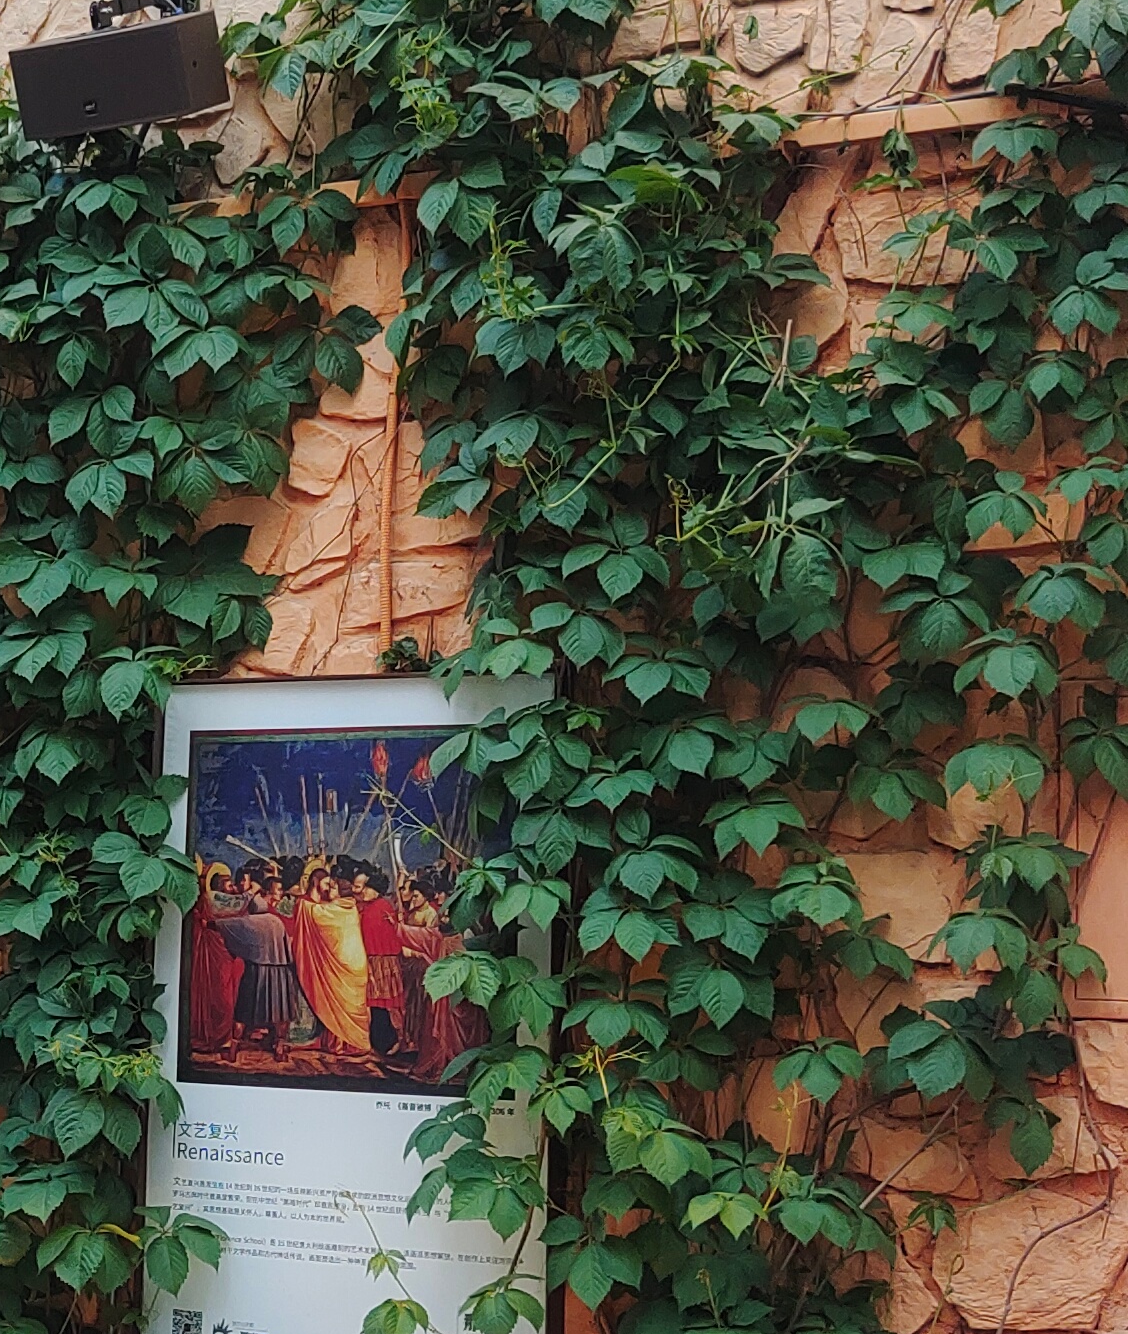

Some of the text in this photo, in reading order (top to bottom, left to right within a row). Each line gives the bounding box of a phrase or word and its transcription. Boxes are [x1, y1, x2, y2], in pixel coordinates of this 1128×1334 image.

[178, 1121, 239, 1142] 文艺复兴
[177, 1142, 284, 1166] Renaissance
